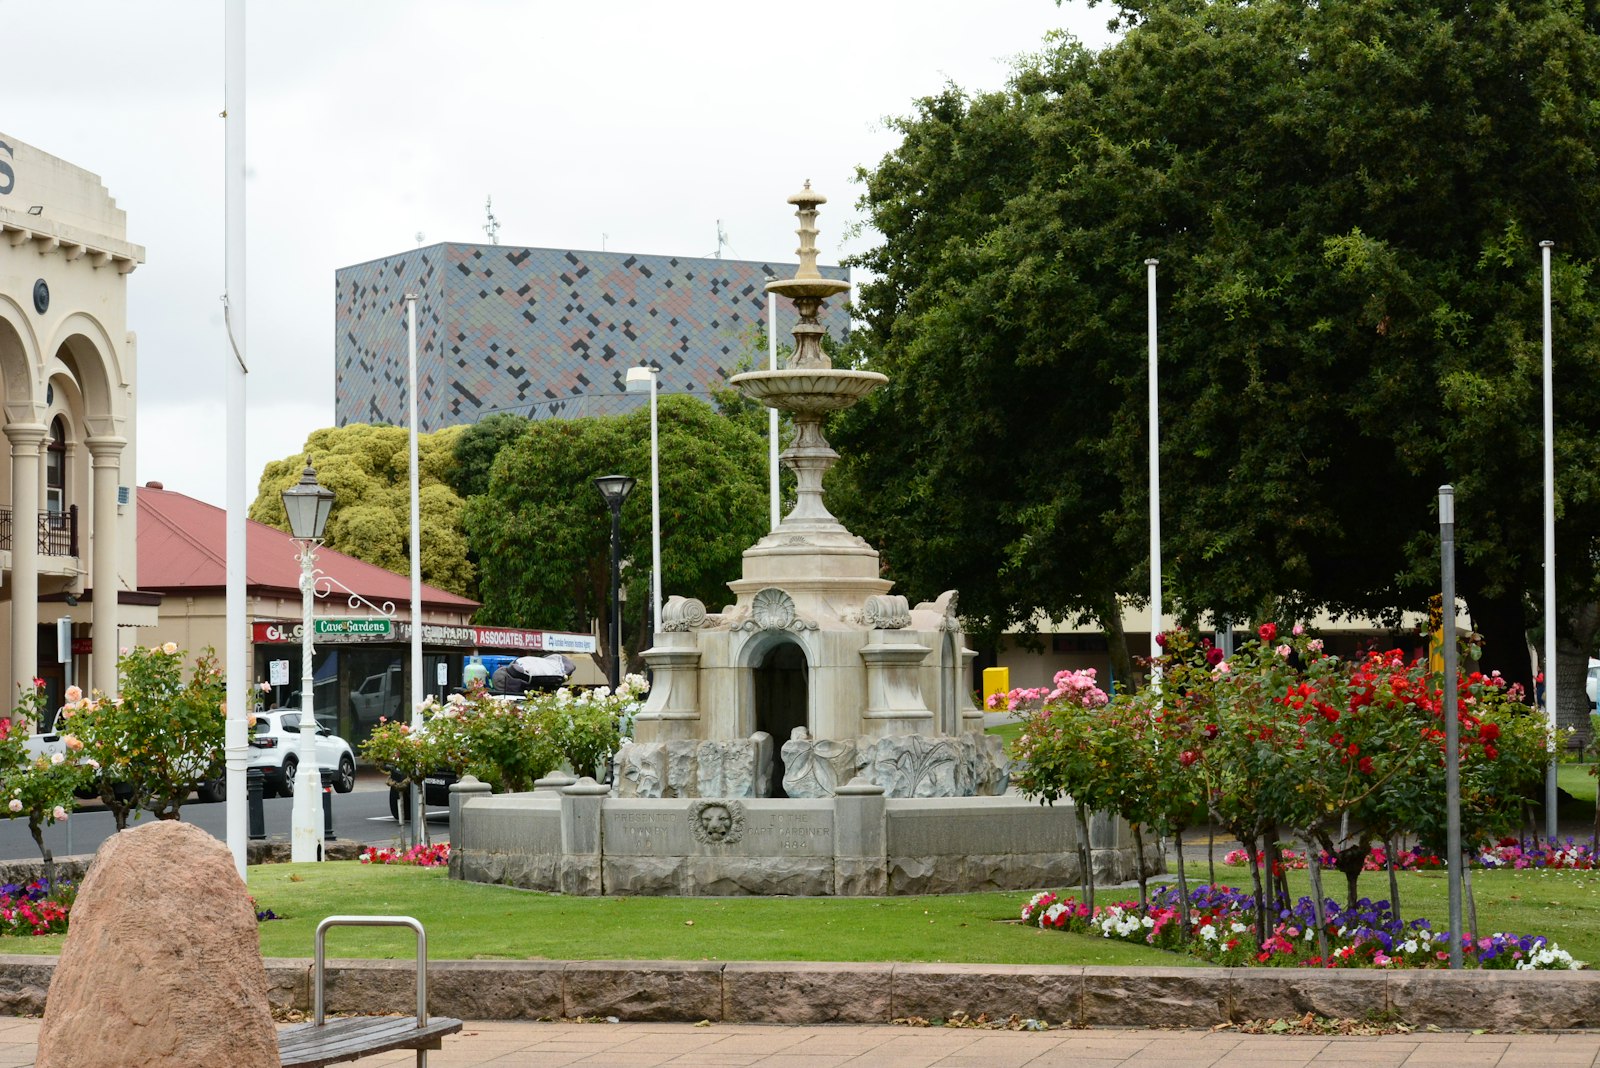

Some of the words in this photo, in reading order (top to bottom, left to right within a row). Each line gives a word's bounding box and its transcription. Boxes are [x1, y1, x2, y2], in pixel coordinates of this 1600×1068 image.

[320, 620, 343, 632] Cave
[346, 620, 385, 632] Gardens
[614, 813, 677, 822] PRESENTED
[770, 814, 784, 822] TO
[787, 814, 808, 822] THE
[623, 826, 652, 835] TOWN
[654, 826, 668, 835] BY
[779, 827, 830, 836] GARDINER
[780, 840, 808, 849] 1884
